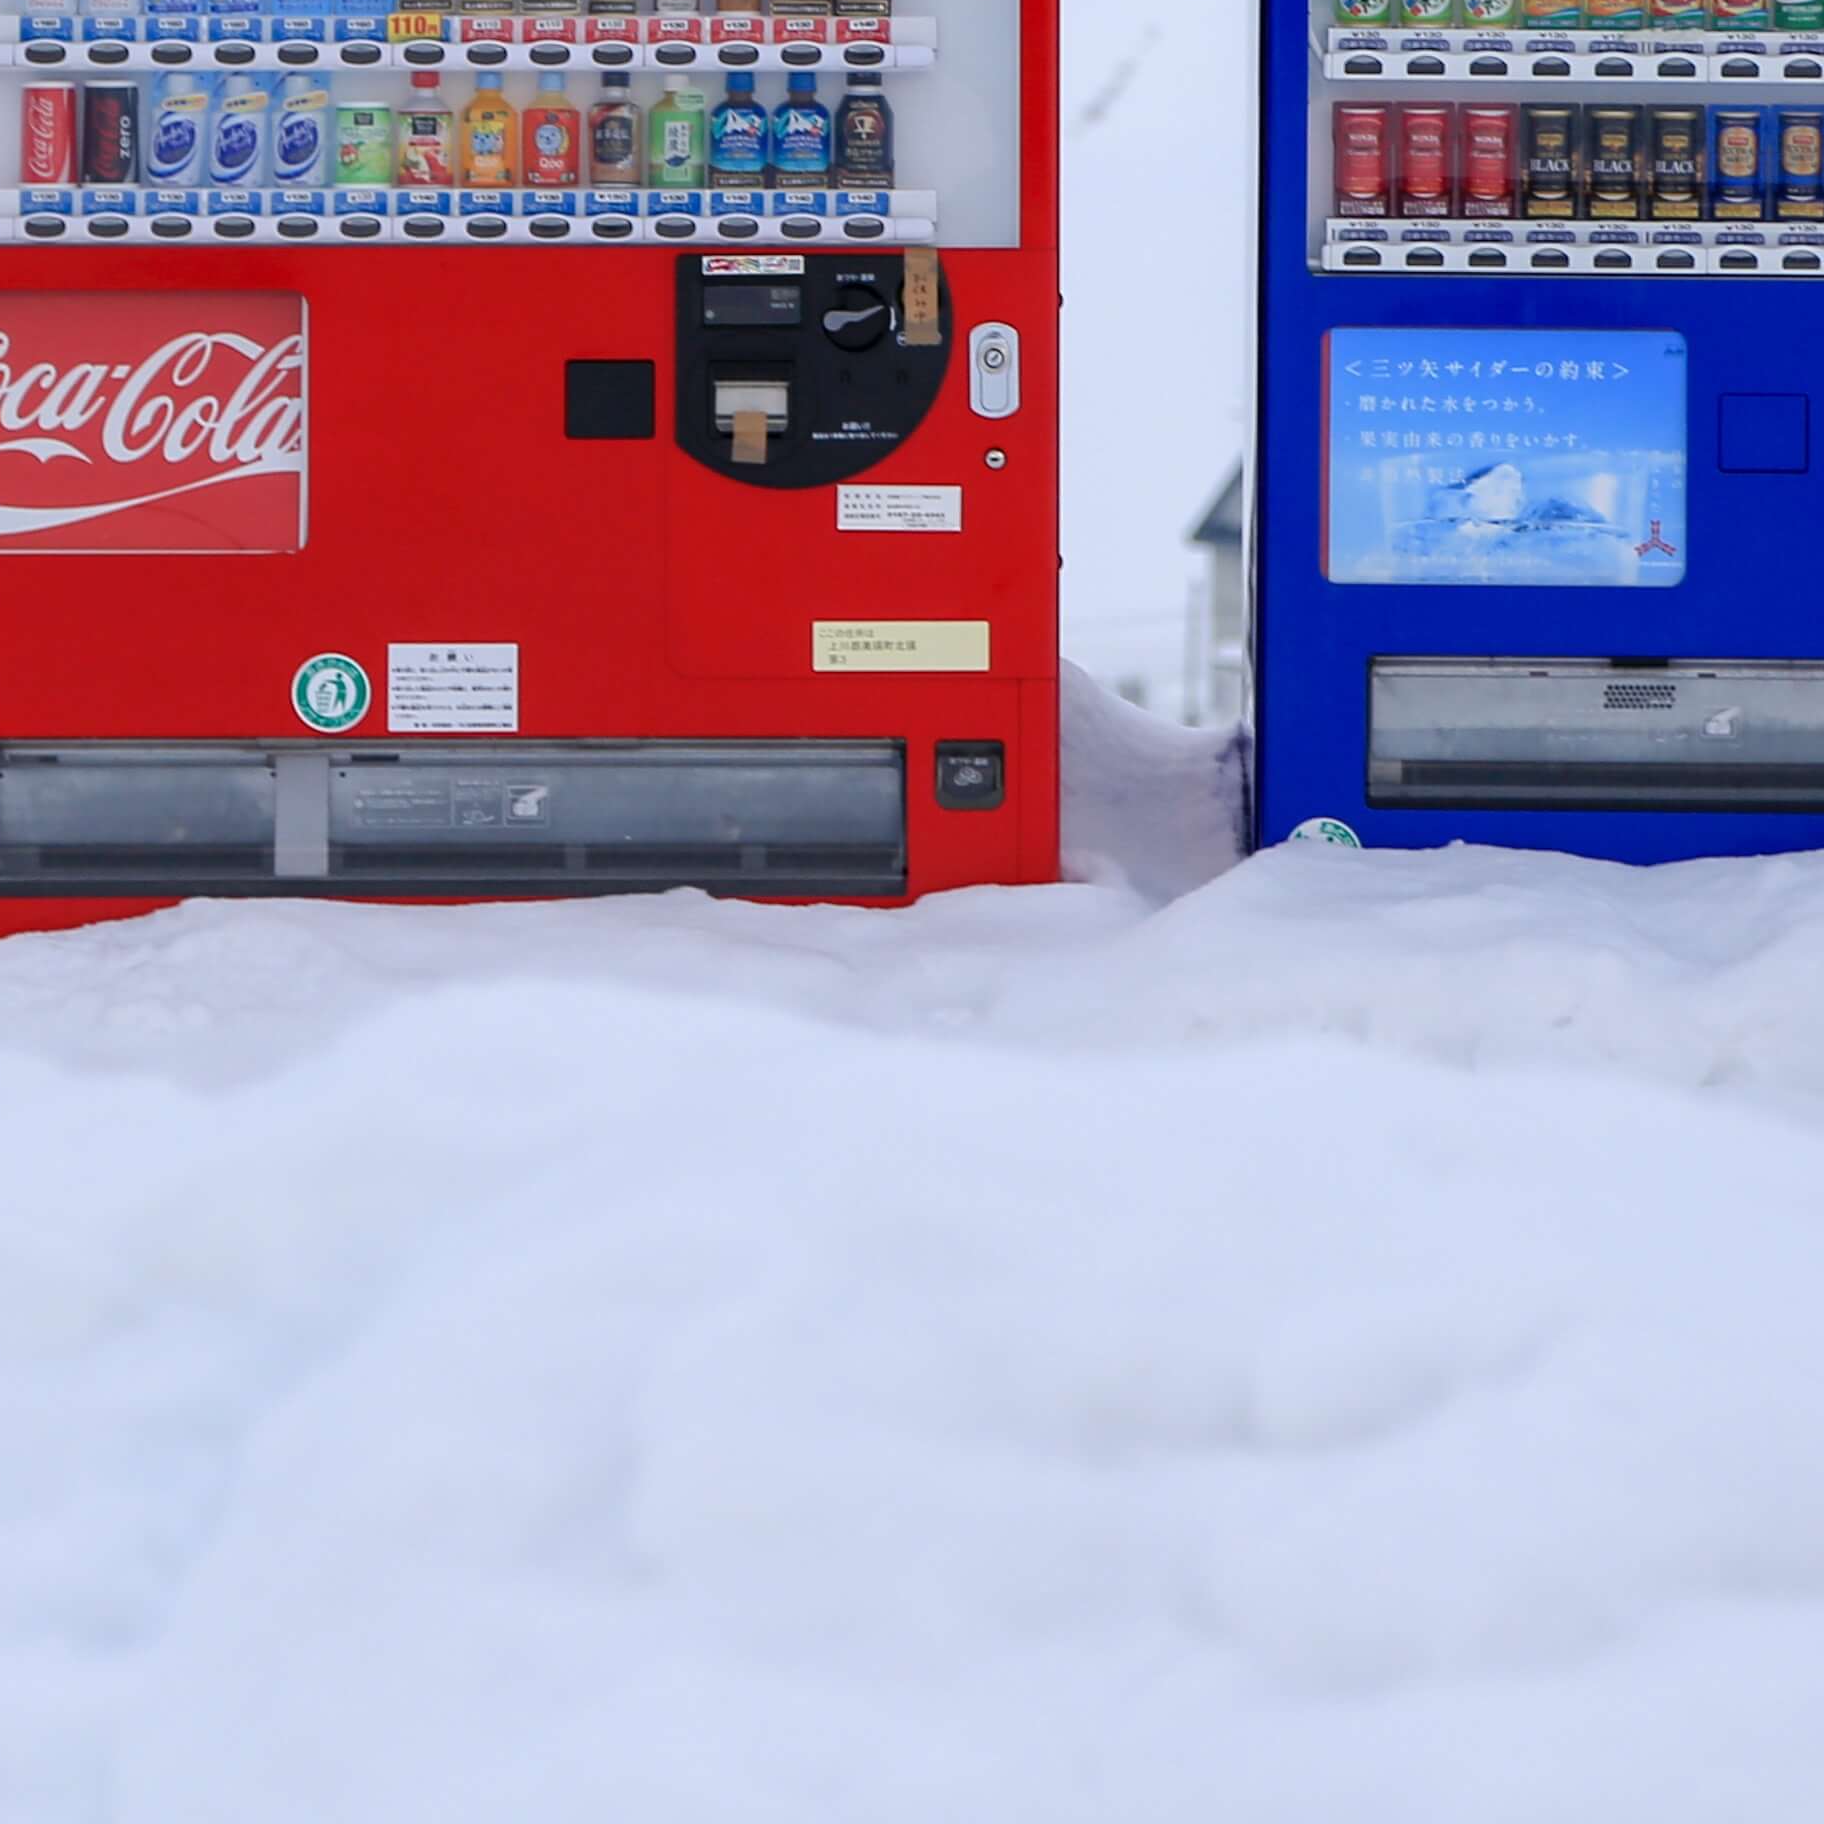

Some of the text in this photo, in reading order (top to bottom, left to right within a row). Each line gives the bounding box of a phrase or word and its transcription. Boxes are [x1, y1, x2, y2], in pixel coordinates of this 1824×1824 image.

[29, 96, 54, 178] Coca-Cola
[119, 115, 132, 160] zero
[539, 156, 565, 169] Qoo
[1530, 159, 1570, 172] BLACK
[1593, 159, 1633, 172] BLACK
[1655, 160, 1695, 174] BLACK
